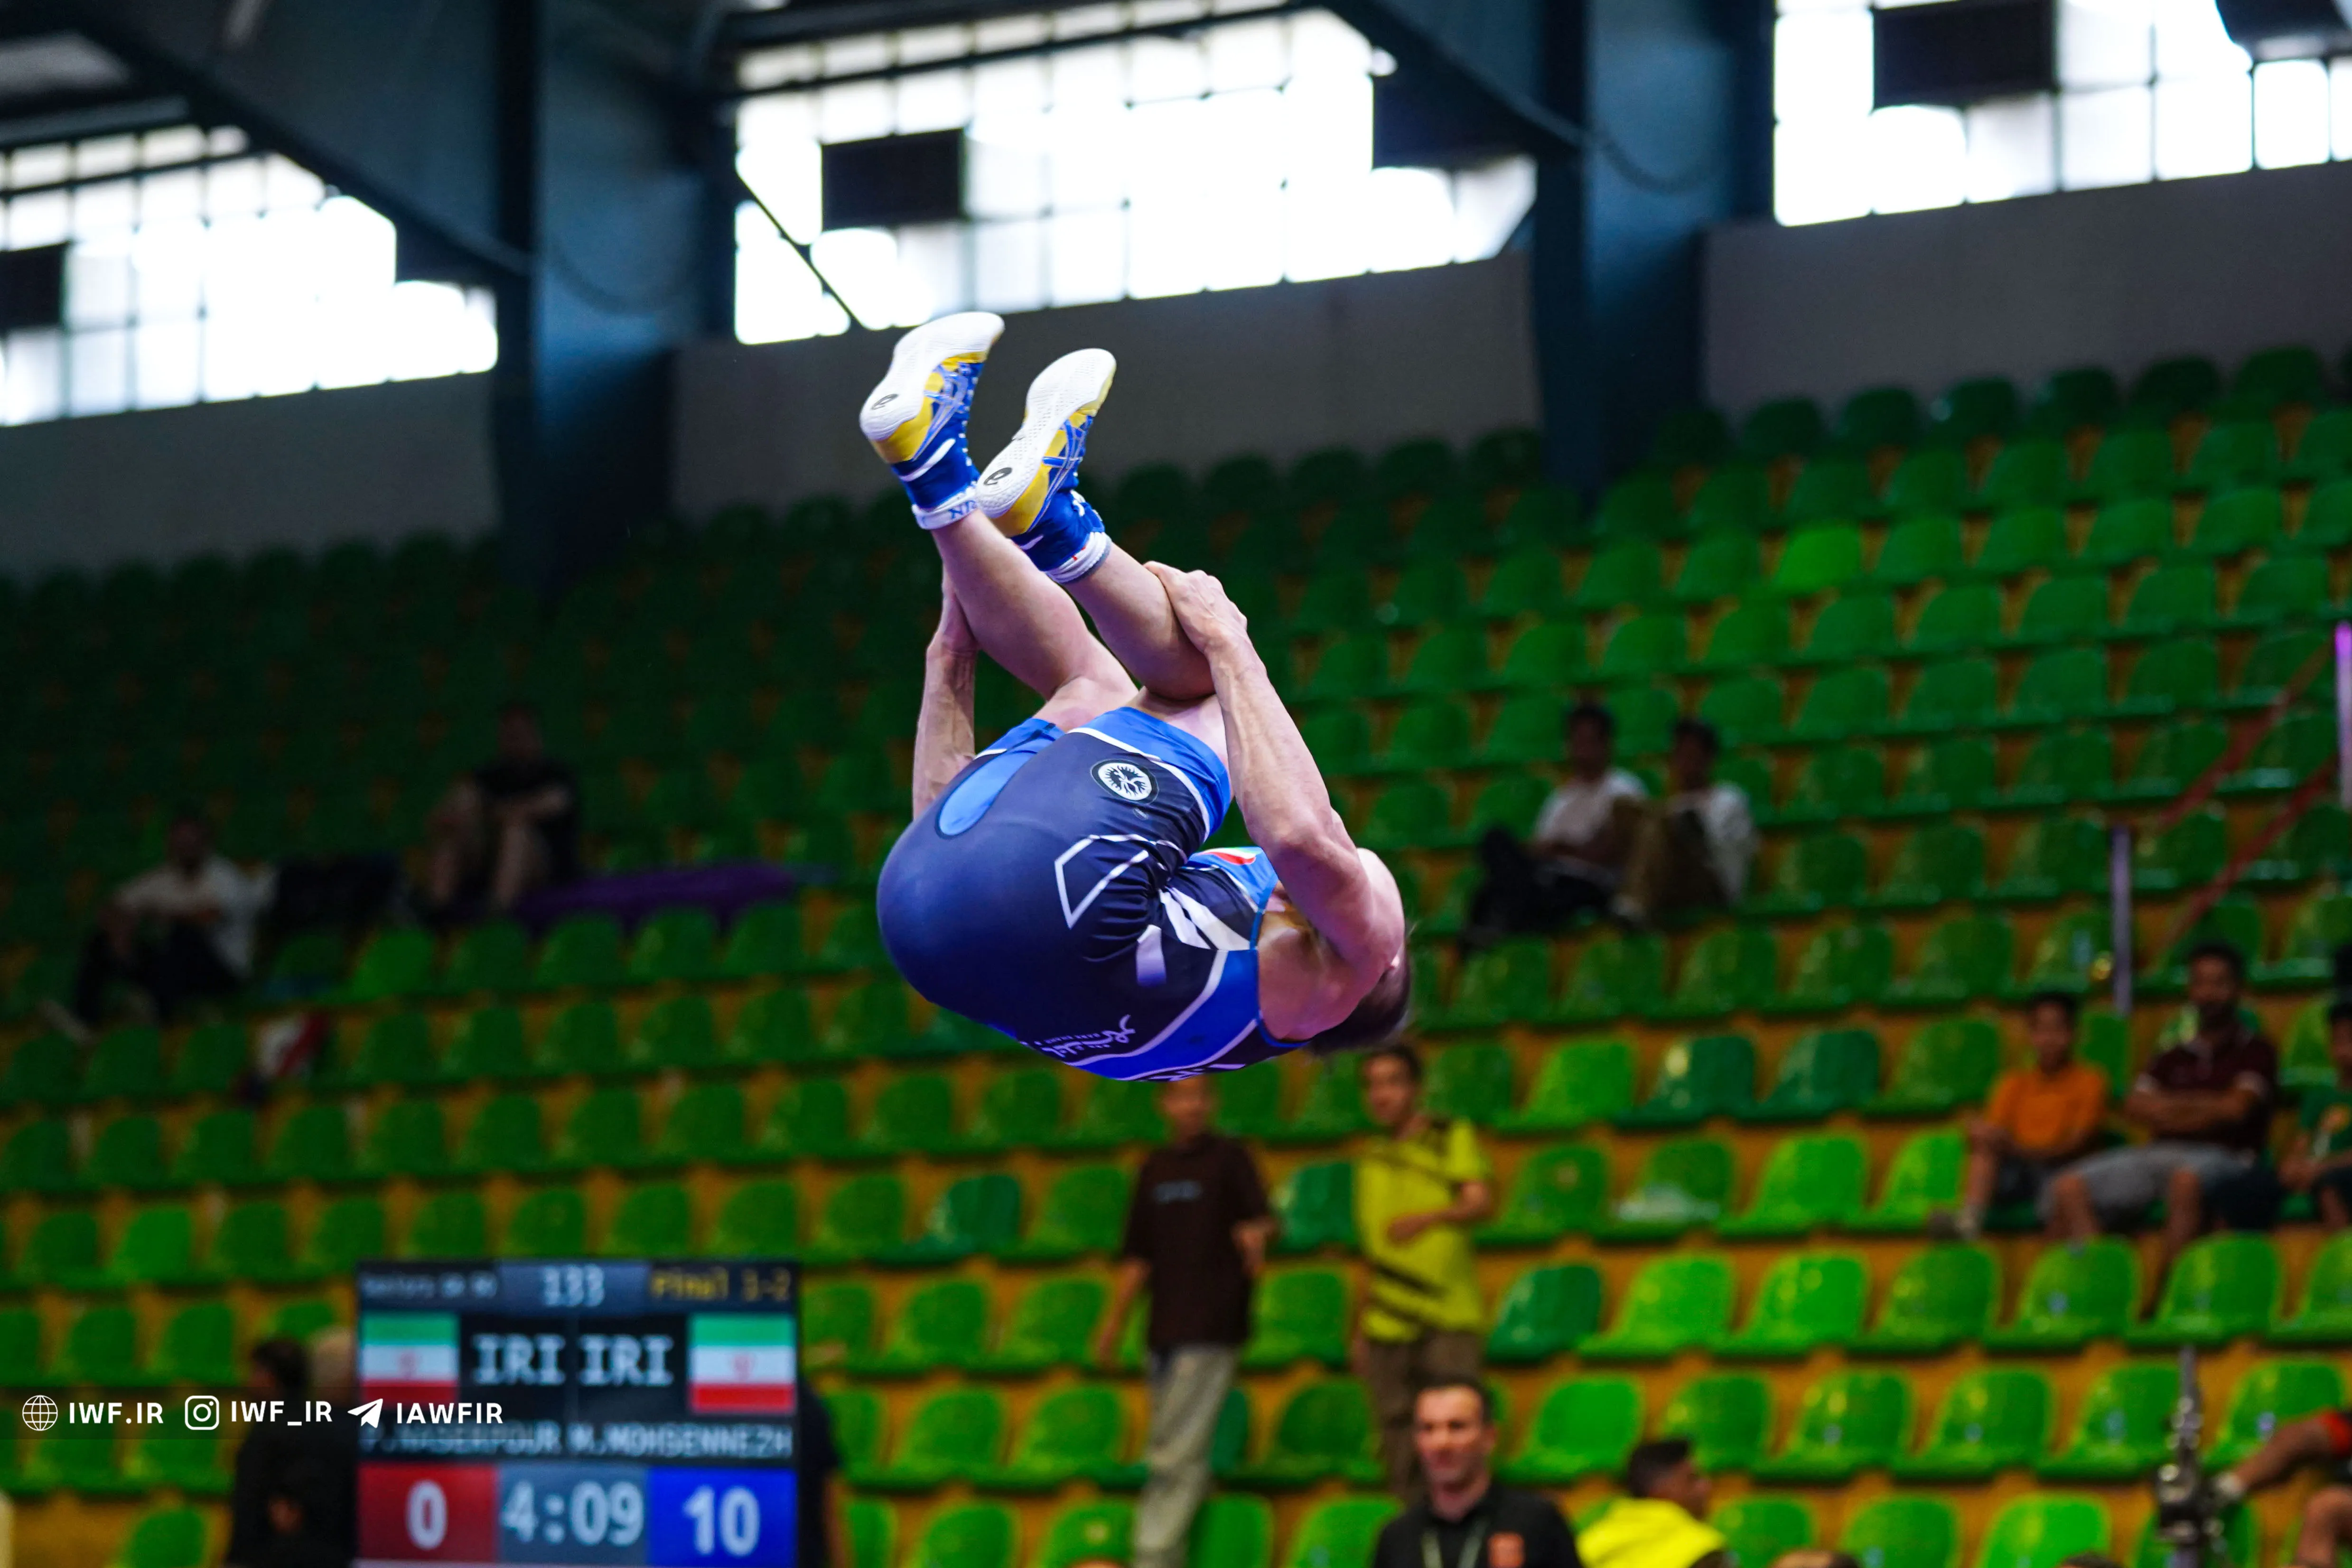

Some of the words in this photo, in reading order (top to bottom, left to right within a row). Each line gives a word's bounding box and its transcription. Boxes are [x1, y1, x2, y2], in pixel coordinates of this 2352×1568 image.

[471, 1333, 566, 1386] IRI
[577, 1333, 674, 1386] IRI
[407, 1480, 448, 1549] 0
[502, 1481, 645, 1546] 4:09
[684, 1485, 760, 1557] 10
